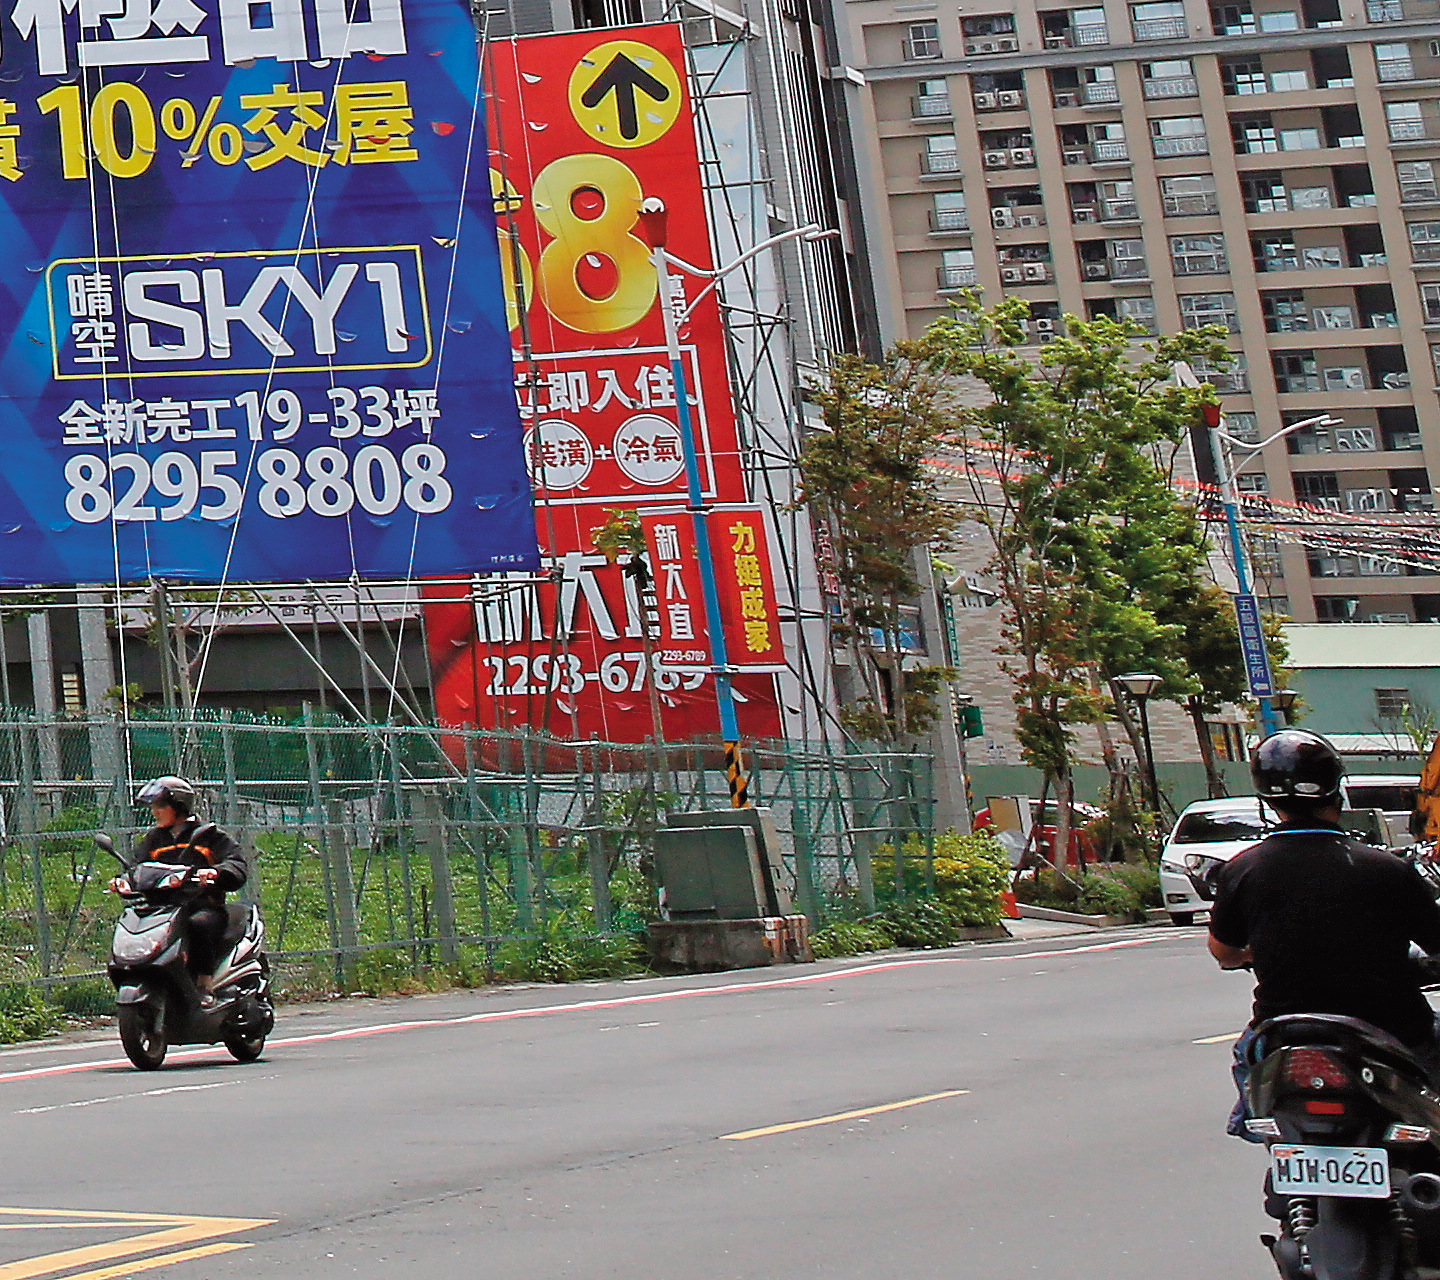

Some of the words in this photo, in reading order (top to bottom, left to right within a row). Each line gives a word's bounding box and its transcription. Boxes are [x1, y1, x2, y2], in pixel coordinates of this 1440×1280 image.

[35, 80, 418, 181] 10%交屋
[67, 273, 120, 364] 晴空
[62, 450, 243, 524] 8295
[255, 444, 452, 520] 8808
[653, 523, 695, 640] 新大直
[728, 521, 772, 653] 力挺成家
